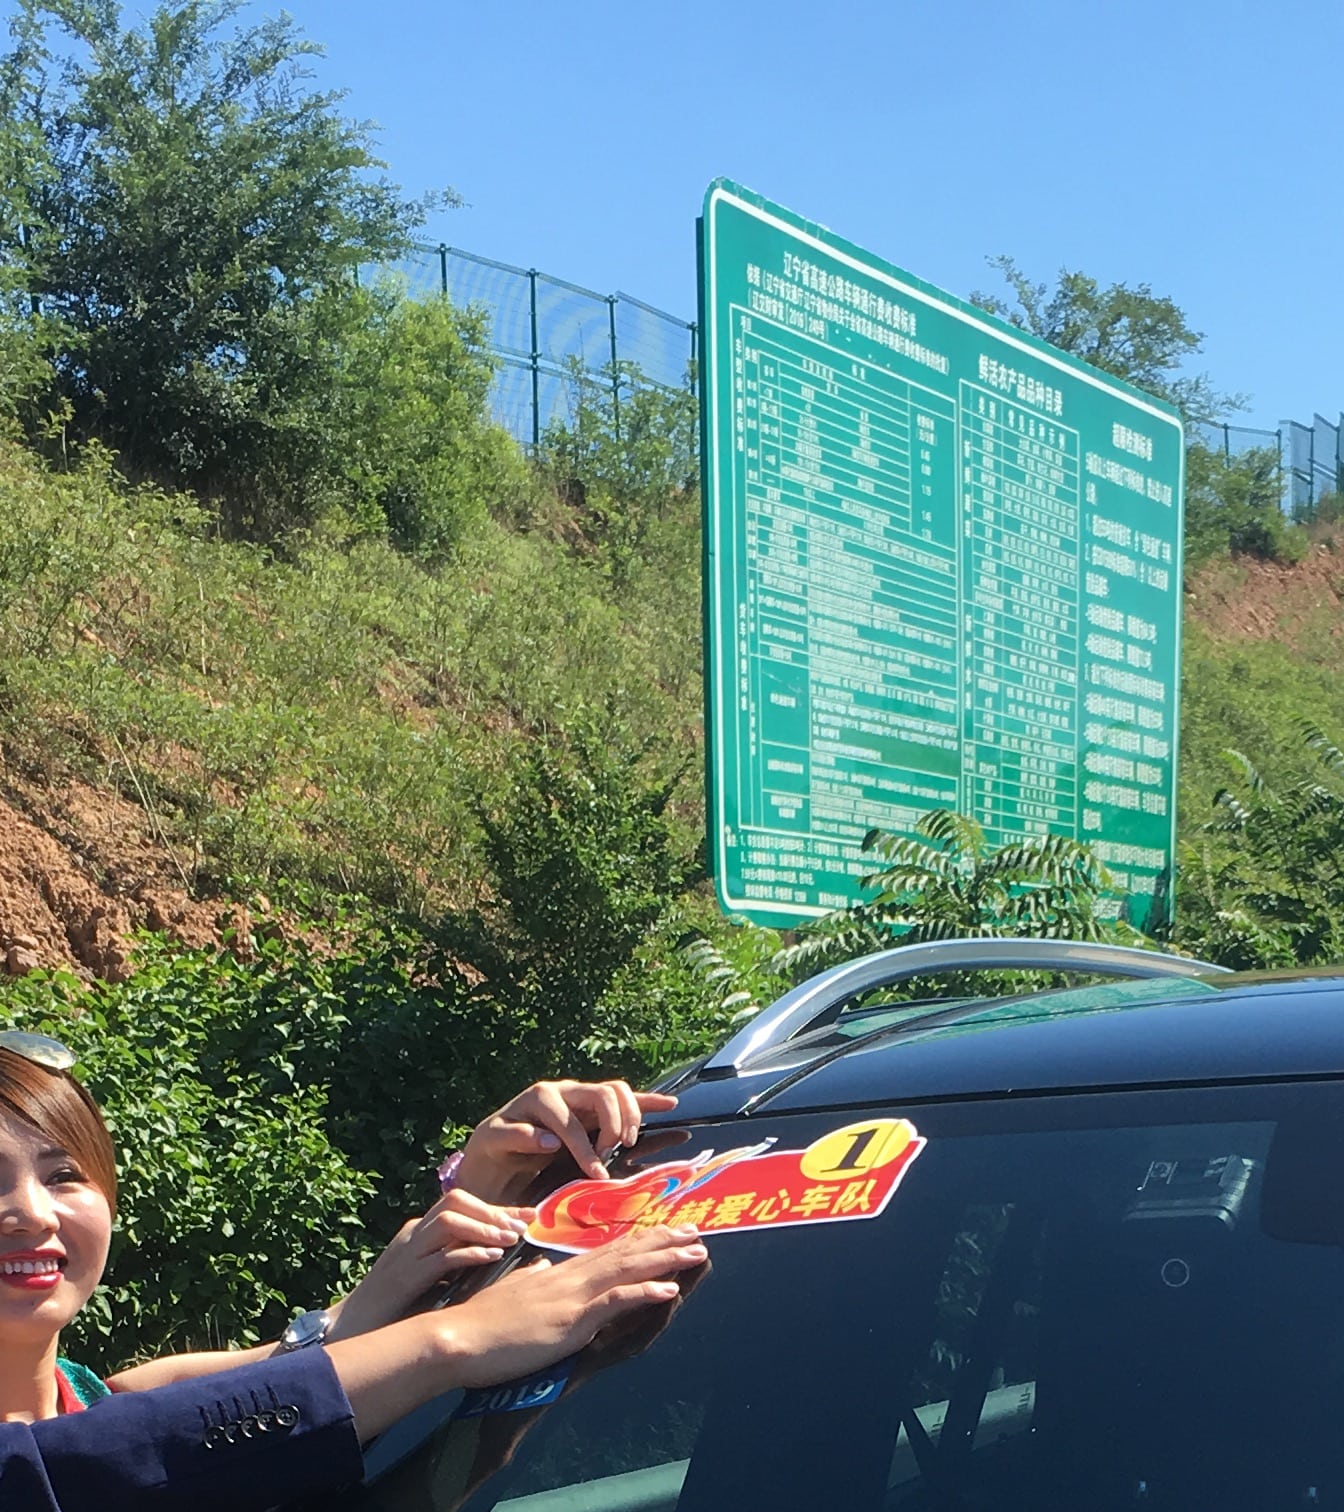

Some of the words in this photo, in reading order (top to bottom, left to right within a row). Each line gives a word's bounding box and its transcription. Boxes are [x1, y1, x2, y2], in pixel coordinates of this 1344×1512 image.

[978, 353, 1063, 417] 鲜活农产品品种目录
[819, 1127, 880, 1173] 1
